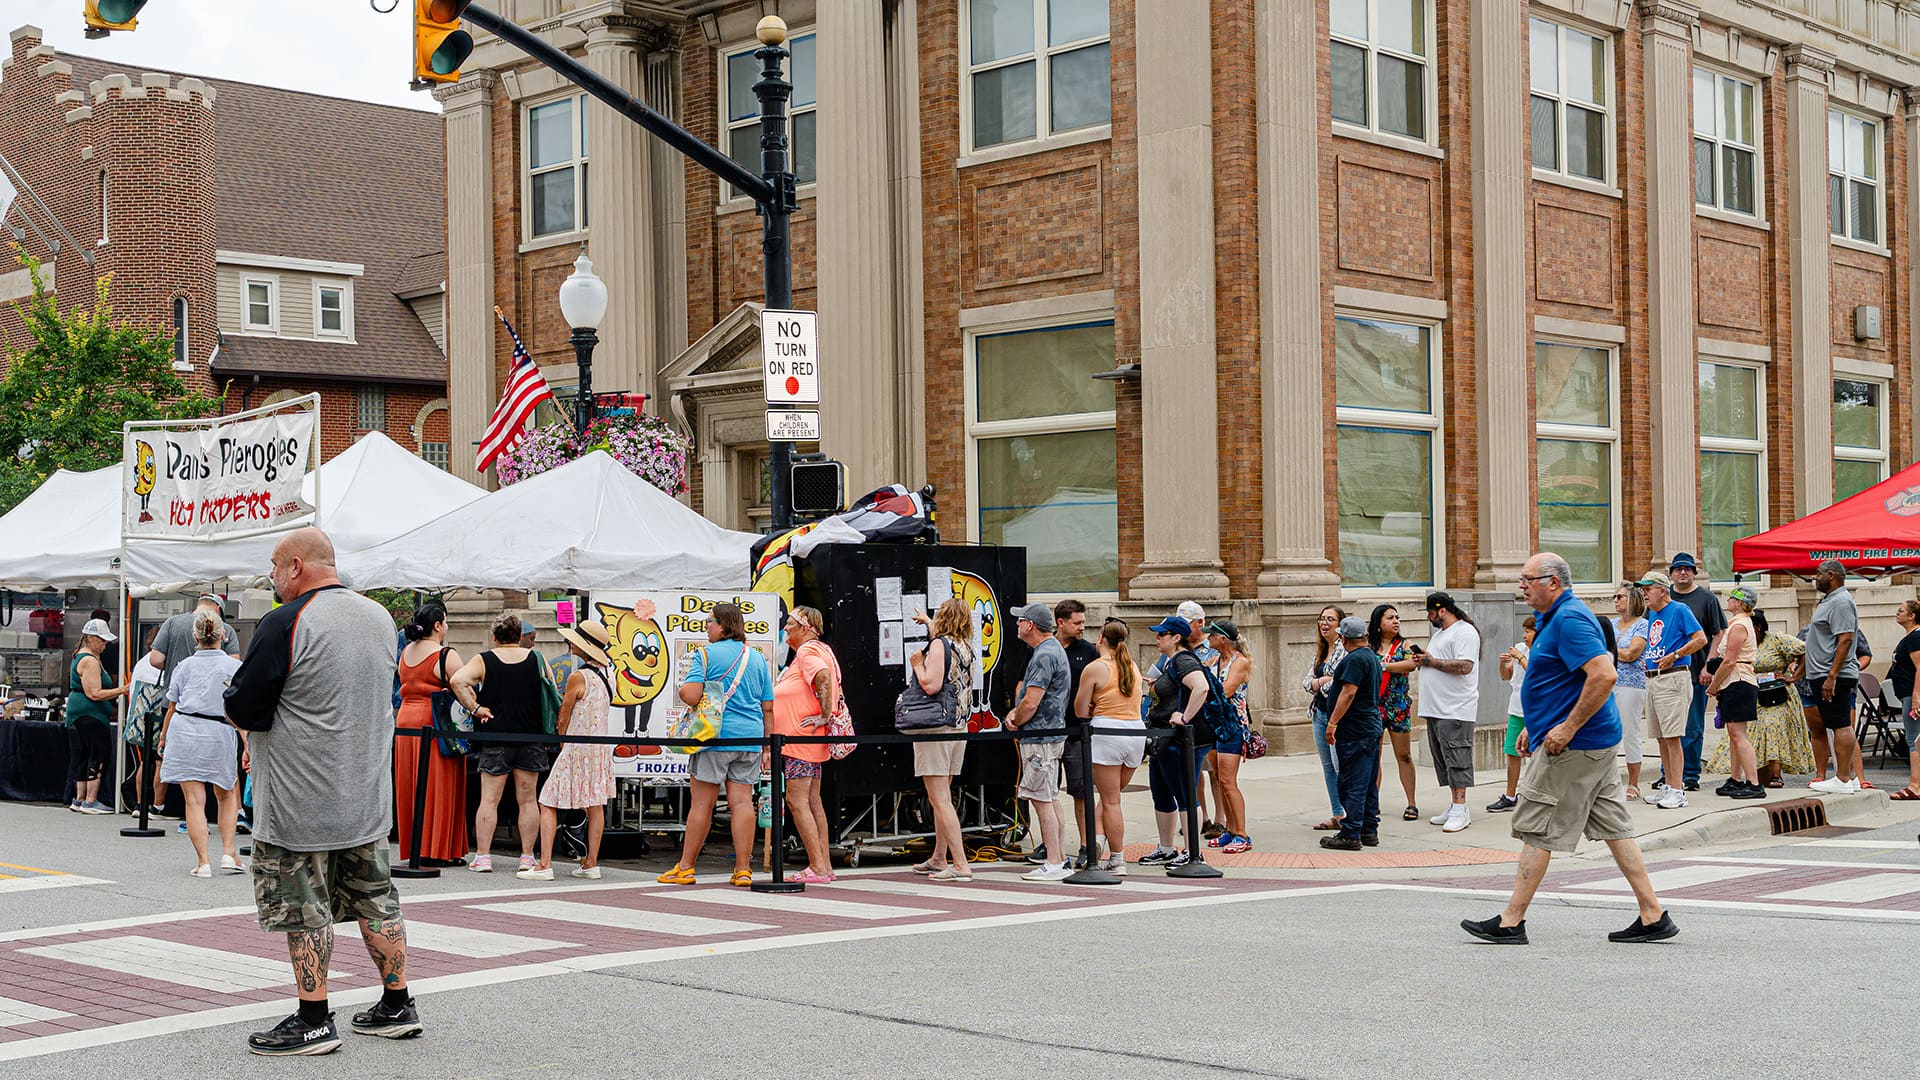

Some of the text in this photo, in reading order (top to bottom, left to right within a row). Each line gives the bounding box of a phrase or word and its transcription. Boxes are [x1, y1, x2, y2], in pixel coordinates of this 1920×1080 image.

[777, 321, 801, 338] NO
[775, 343, 806, 357] TURN
[769, 361, 814, 375] ON RED
[779, 421, 809, 429] CHILDREN
[200, 489, 271, 525] ORDERS
[1809, 550, 1860, 560] WHITING
[1863, 549, 1888, 559] FIRE
[681, 595, 756, 614] Da's
[636, 763, 687, 774] FROZEN
[304, 1025, 330, 1042] HOKA
